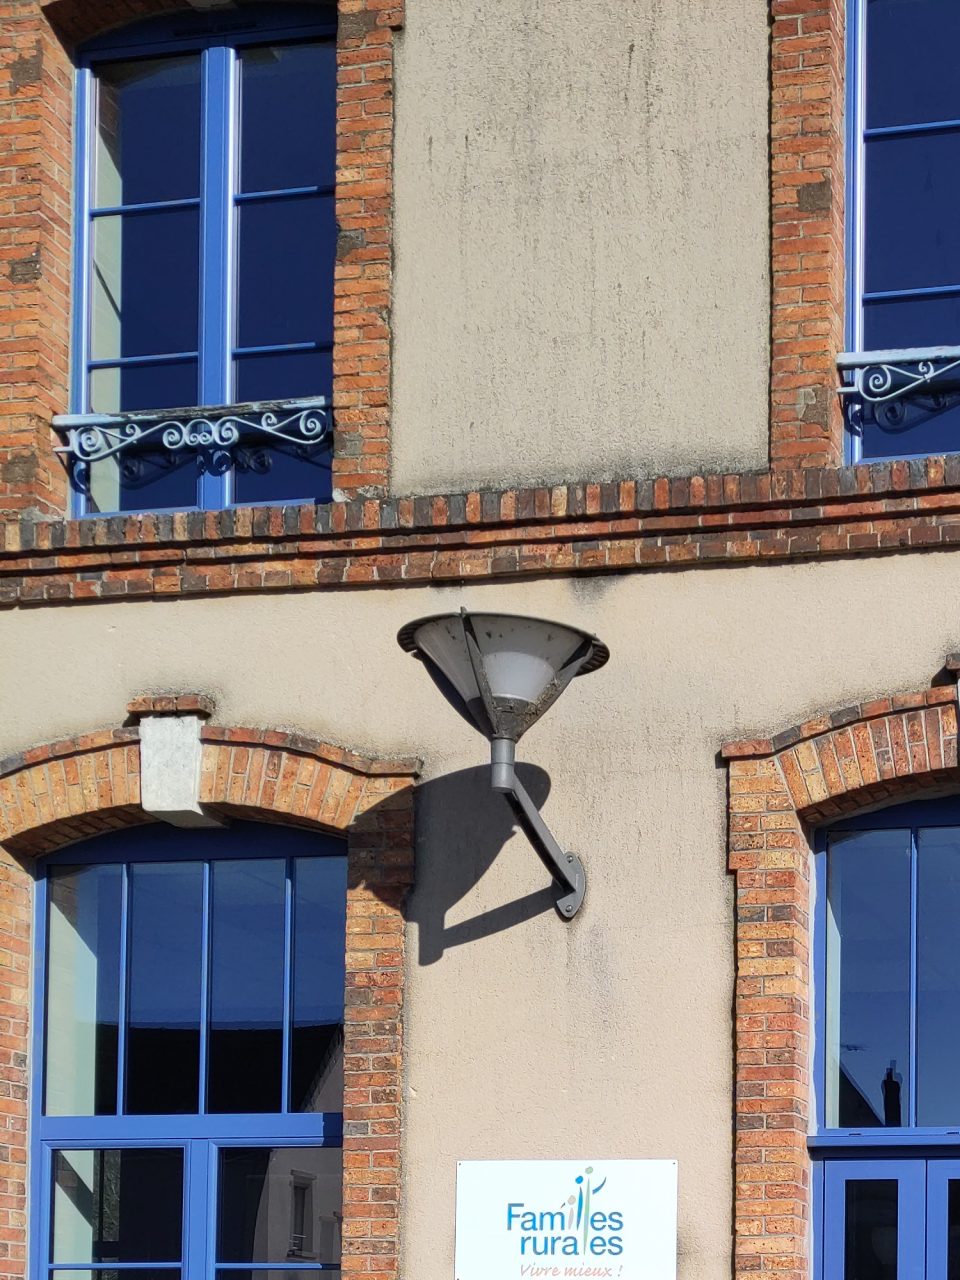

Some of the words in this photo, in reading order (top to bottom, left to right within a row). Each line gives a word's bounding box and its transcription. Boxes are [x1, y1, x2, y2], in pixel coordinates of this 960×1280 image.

[507, 1178, 624, 1231] Familles
[520, 1234, 624, 1256] rurales
[520, 1262, 561, 1277] Vivre
[563, 1262, 613, 1277] mieux
